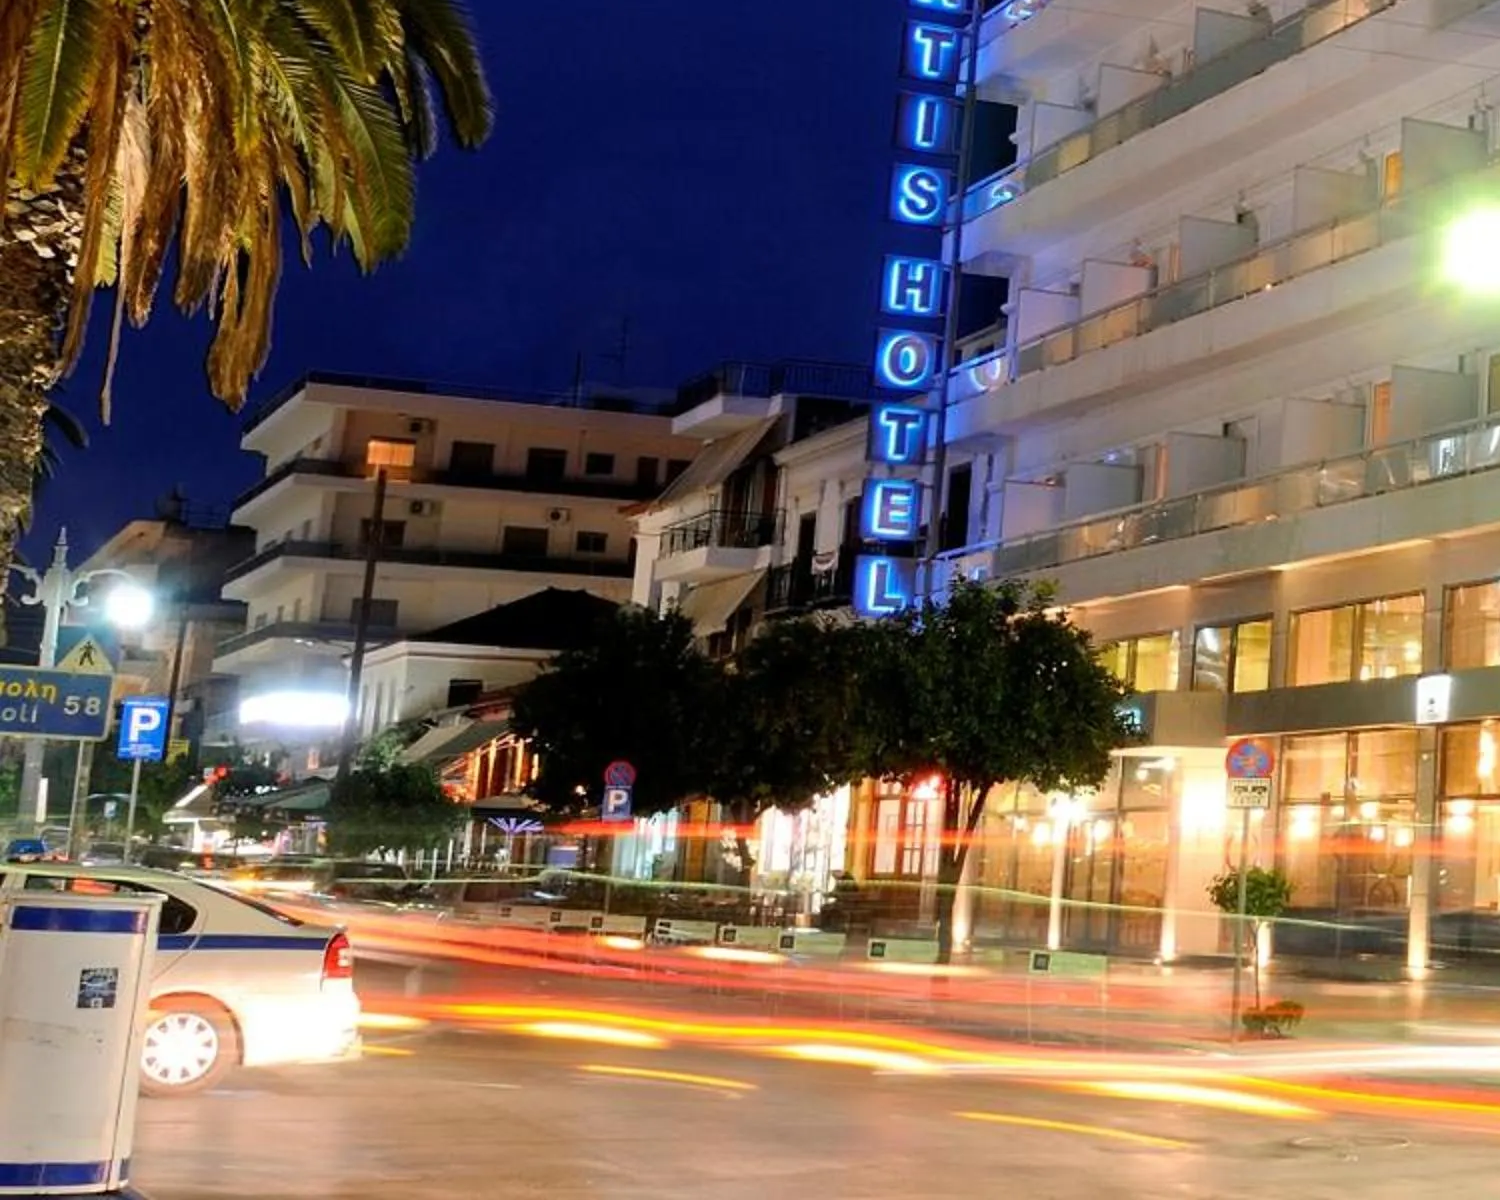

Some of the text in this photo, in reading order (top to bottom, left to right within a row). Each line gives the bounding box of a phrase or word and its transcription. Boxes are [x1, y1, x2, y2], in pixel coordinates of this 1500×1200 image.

[867, 259, 937, 612] HOTEL
[64, 695, 101, 716] 58
[129, 707, 161, 742] P
[608, 790, 628, 812] P
